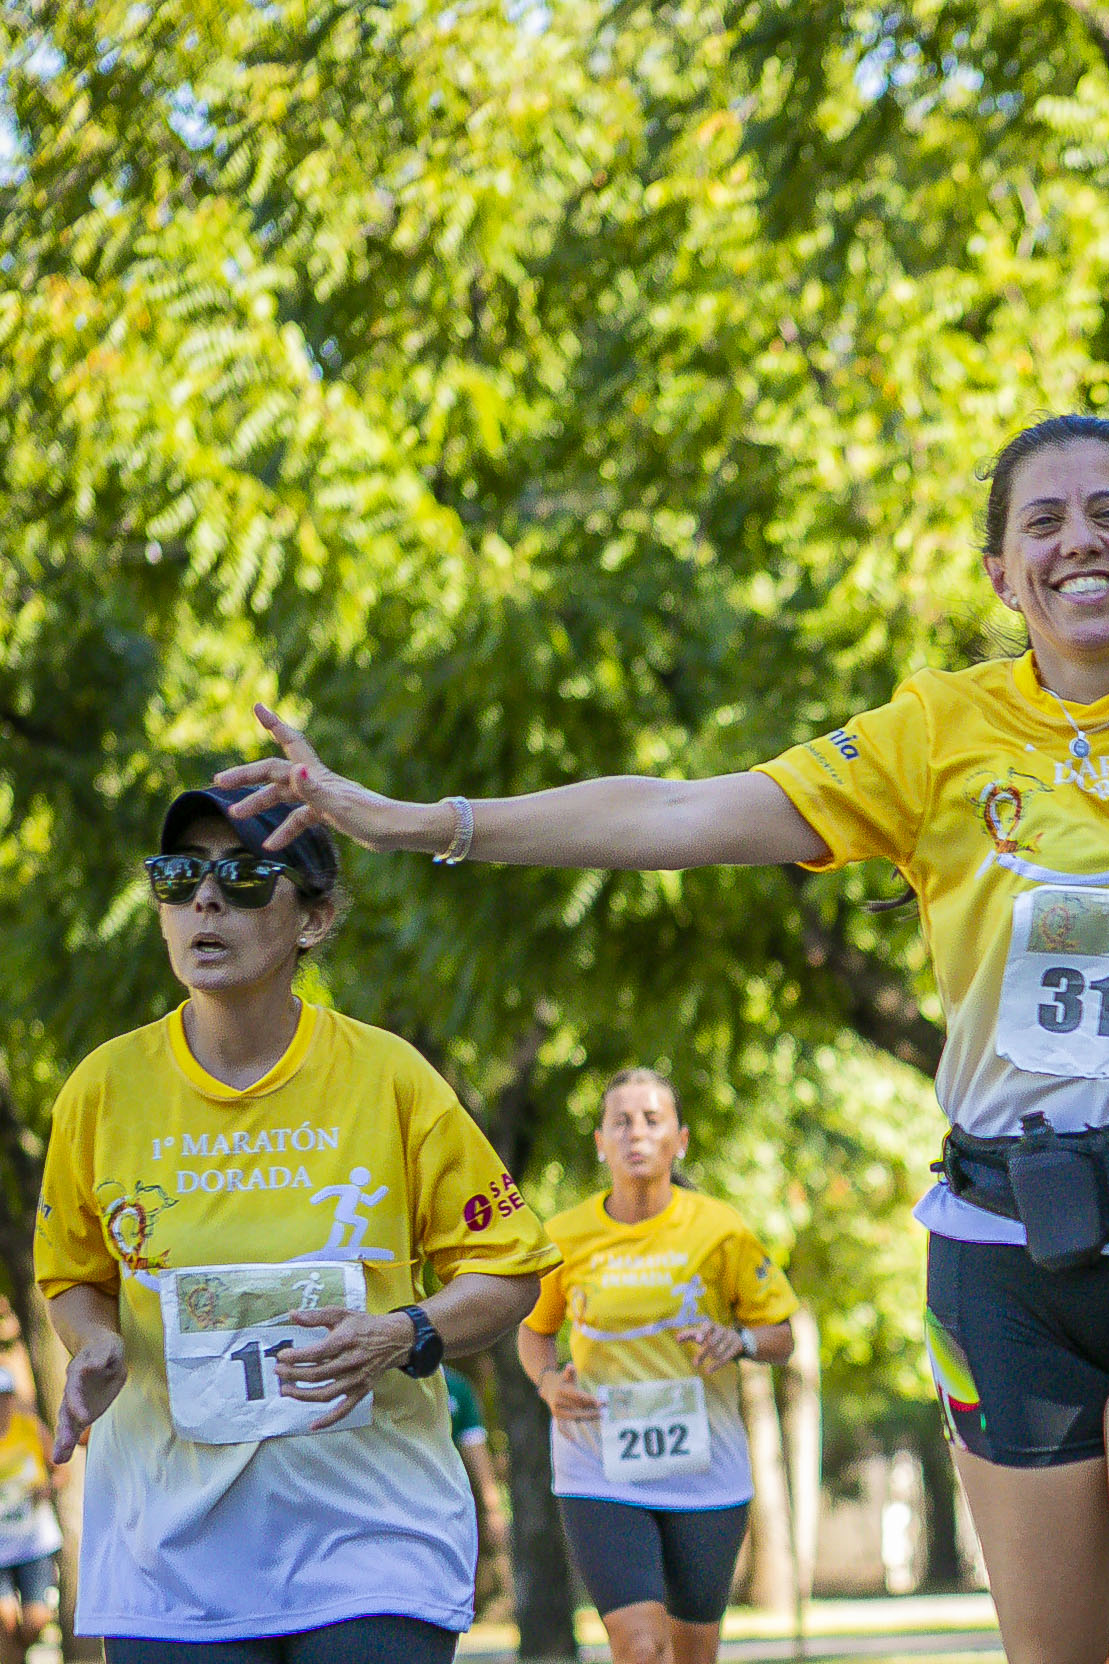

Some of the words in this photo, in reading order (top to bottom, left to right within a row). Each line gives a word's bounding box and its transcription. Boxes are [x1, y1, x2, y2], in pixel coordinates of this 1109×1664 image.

[180, 1120, 341, 1158] MARATÓN
[175, 1165, 315, 1194] DORADA
[618, 1423, 691, 1460] 202
